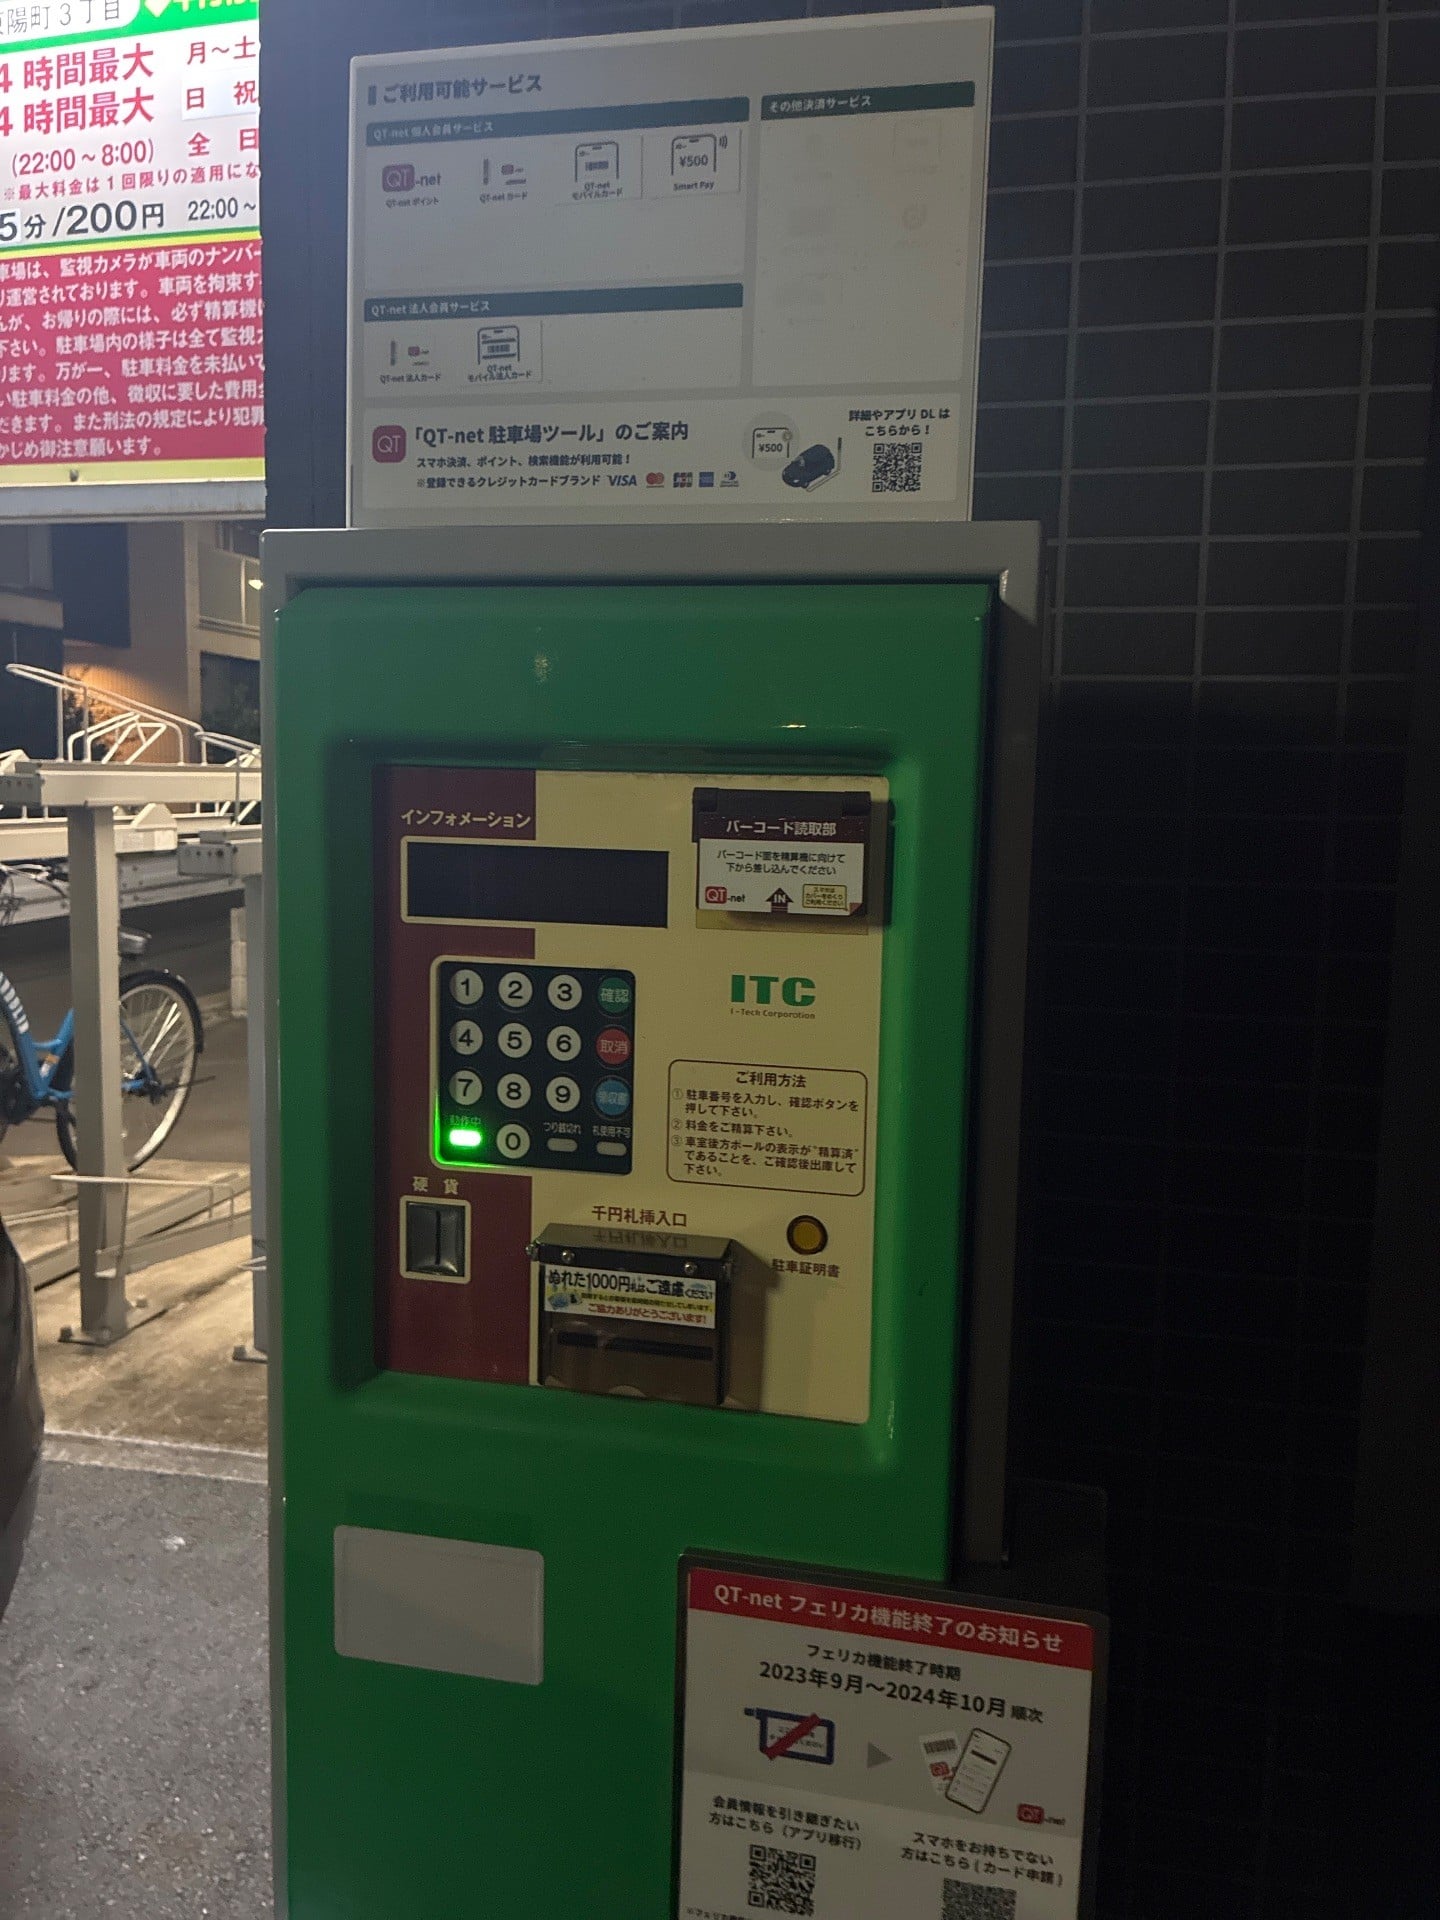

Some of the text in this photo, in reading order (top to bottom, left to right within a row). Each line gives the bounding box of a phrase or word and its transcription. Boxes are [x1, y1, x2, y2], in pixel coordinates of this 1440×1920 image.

[0, 0, 119, 35] 陽町3丁目
[384, 74, 543, 103] ご利用可能サービス
[680, 154, 709, 167] ¥500
[371, 305, 408, 317] QT-net
[920, 409, 936, 419] DL
[757, 443, 783, 455] ¥500
[608, 475, 637, 487] VISA
[401, 809, 531, 828] インフォメーション
[726, 820, 837, 837] バーコード読取部
[726, 862, 837, 875] 下から差し込んでください
[705, 886, 746, 904] QT-net
[773, 893, 787, 903] IN
[460, 978, 469, 996] 1
[508, 980, 523, 999] 2
[557, 983, 572, 1001] 3
[600, 988, 629, 1003] 確認
[731, 974, 816, 1007] ITC
[458, 1029, 474, 1047] 4
[507, 1031, 522, 1049] 5
[556, 1034, 571, 1053] 6
[600, 1040, 628, 1055] 取消
[457, 1078, 473, 1097] 7
[736, 1071, 807, 1088] ご利用方法
[506, 1082, 522, 1100] 8
[555, 1085, 571, 1103] 9
[685, 1103, 758, 1119] 押して下さい。
[686, 1120, 793, 1138] 料金をご精算下さい。
[505, 1132, 521, 1150] 0
[683, 1163, 722, 1176] 下さい。
[592, 1205, 687, 1227] 千円札挿入口
[772, 1258, 840, 1278] 駐車証明書
[714, 1584, 1063, 1652] QT-net フェリカ機能終了のお知らせ
[807, 1644, 961, 1681] フェリカ機能終了時期
[1010, 1705, 1044, 1723] 順次
[913, 1831, 1053, 1865] スマホをお持ちでない
